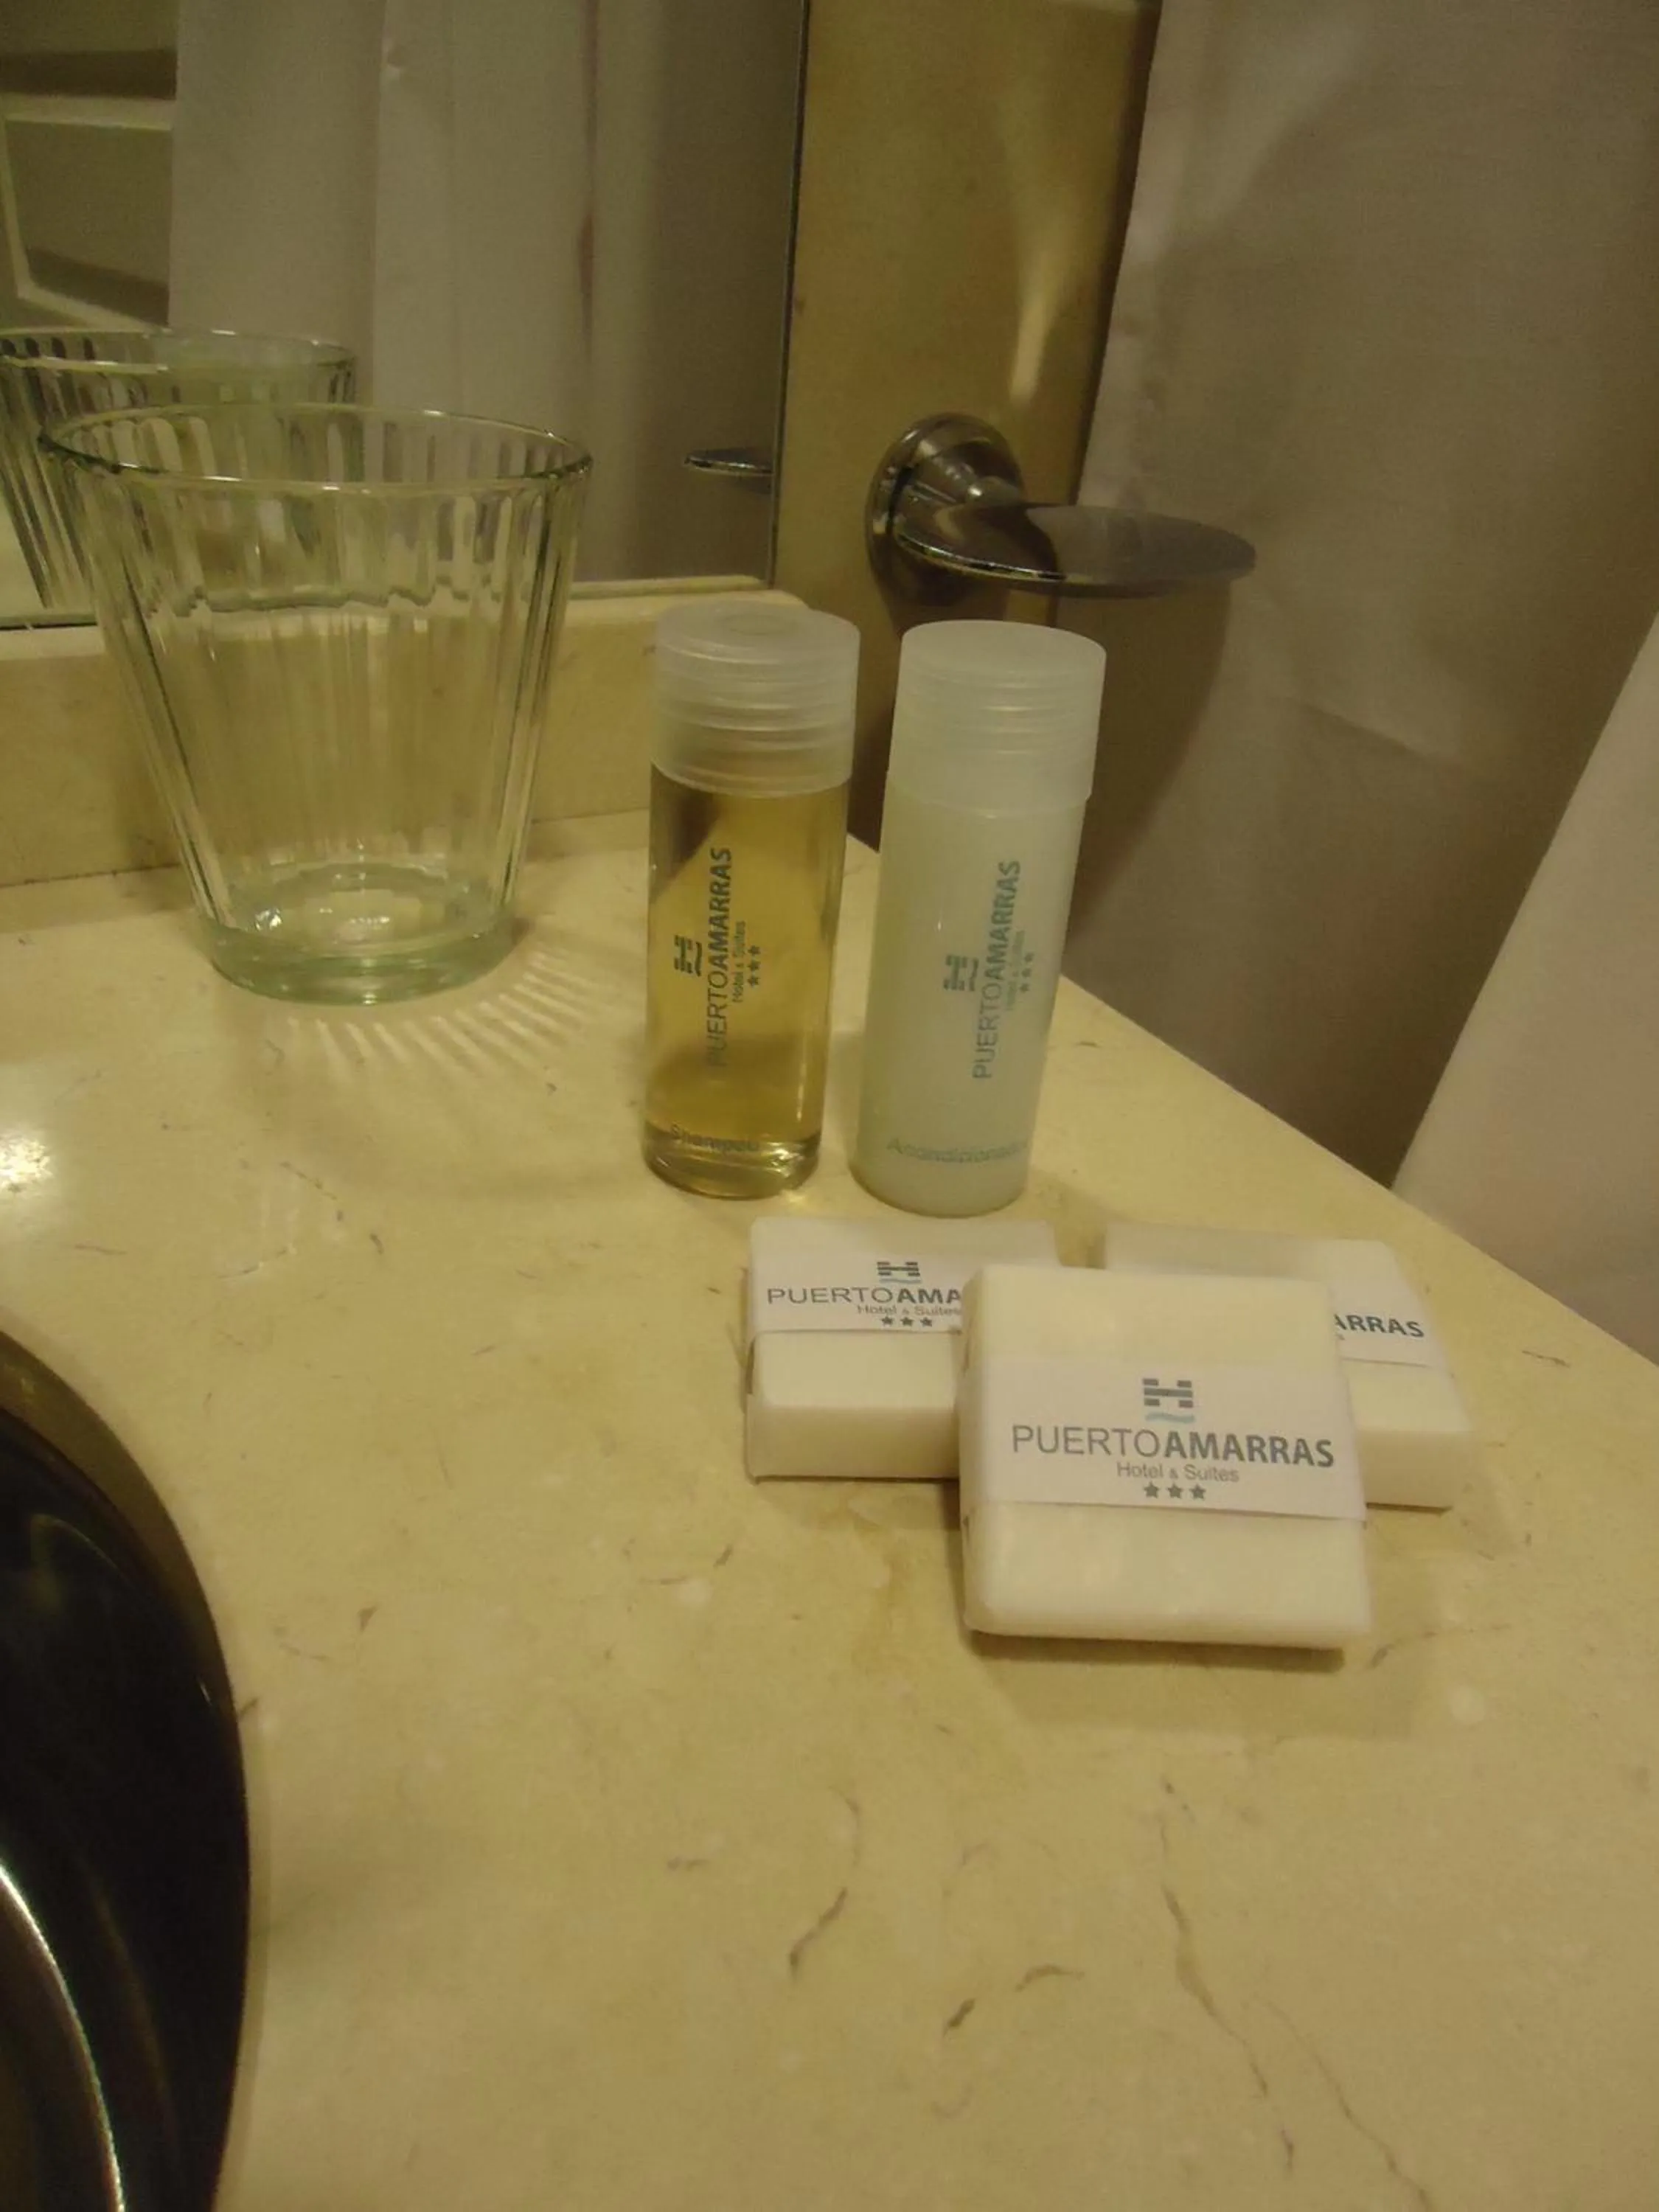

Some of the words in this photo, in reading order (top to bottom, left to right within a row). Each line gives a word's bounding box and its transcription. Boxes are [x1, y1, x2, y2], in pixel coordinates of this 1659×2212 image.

[706, 846, 732, 1068] PUERTOAMARRAS
[972, 860, 1020, 1079] PUERTOAMARRAS
[767, 1287, 961, 1305] PUERTOAMA
[858, 1304, 897, 1315] Hotel
[1012, 1425, 1335, 1467] PUERTOAMARRAS
[1116, 1461, 1164, 1480] Hotel
[1169, 1468, 1179, 1480] &
[1183, 1463, 1240, 1483] Suites
